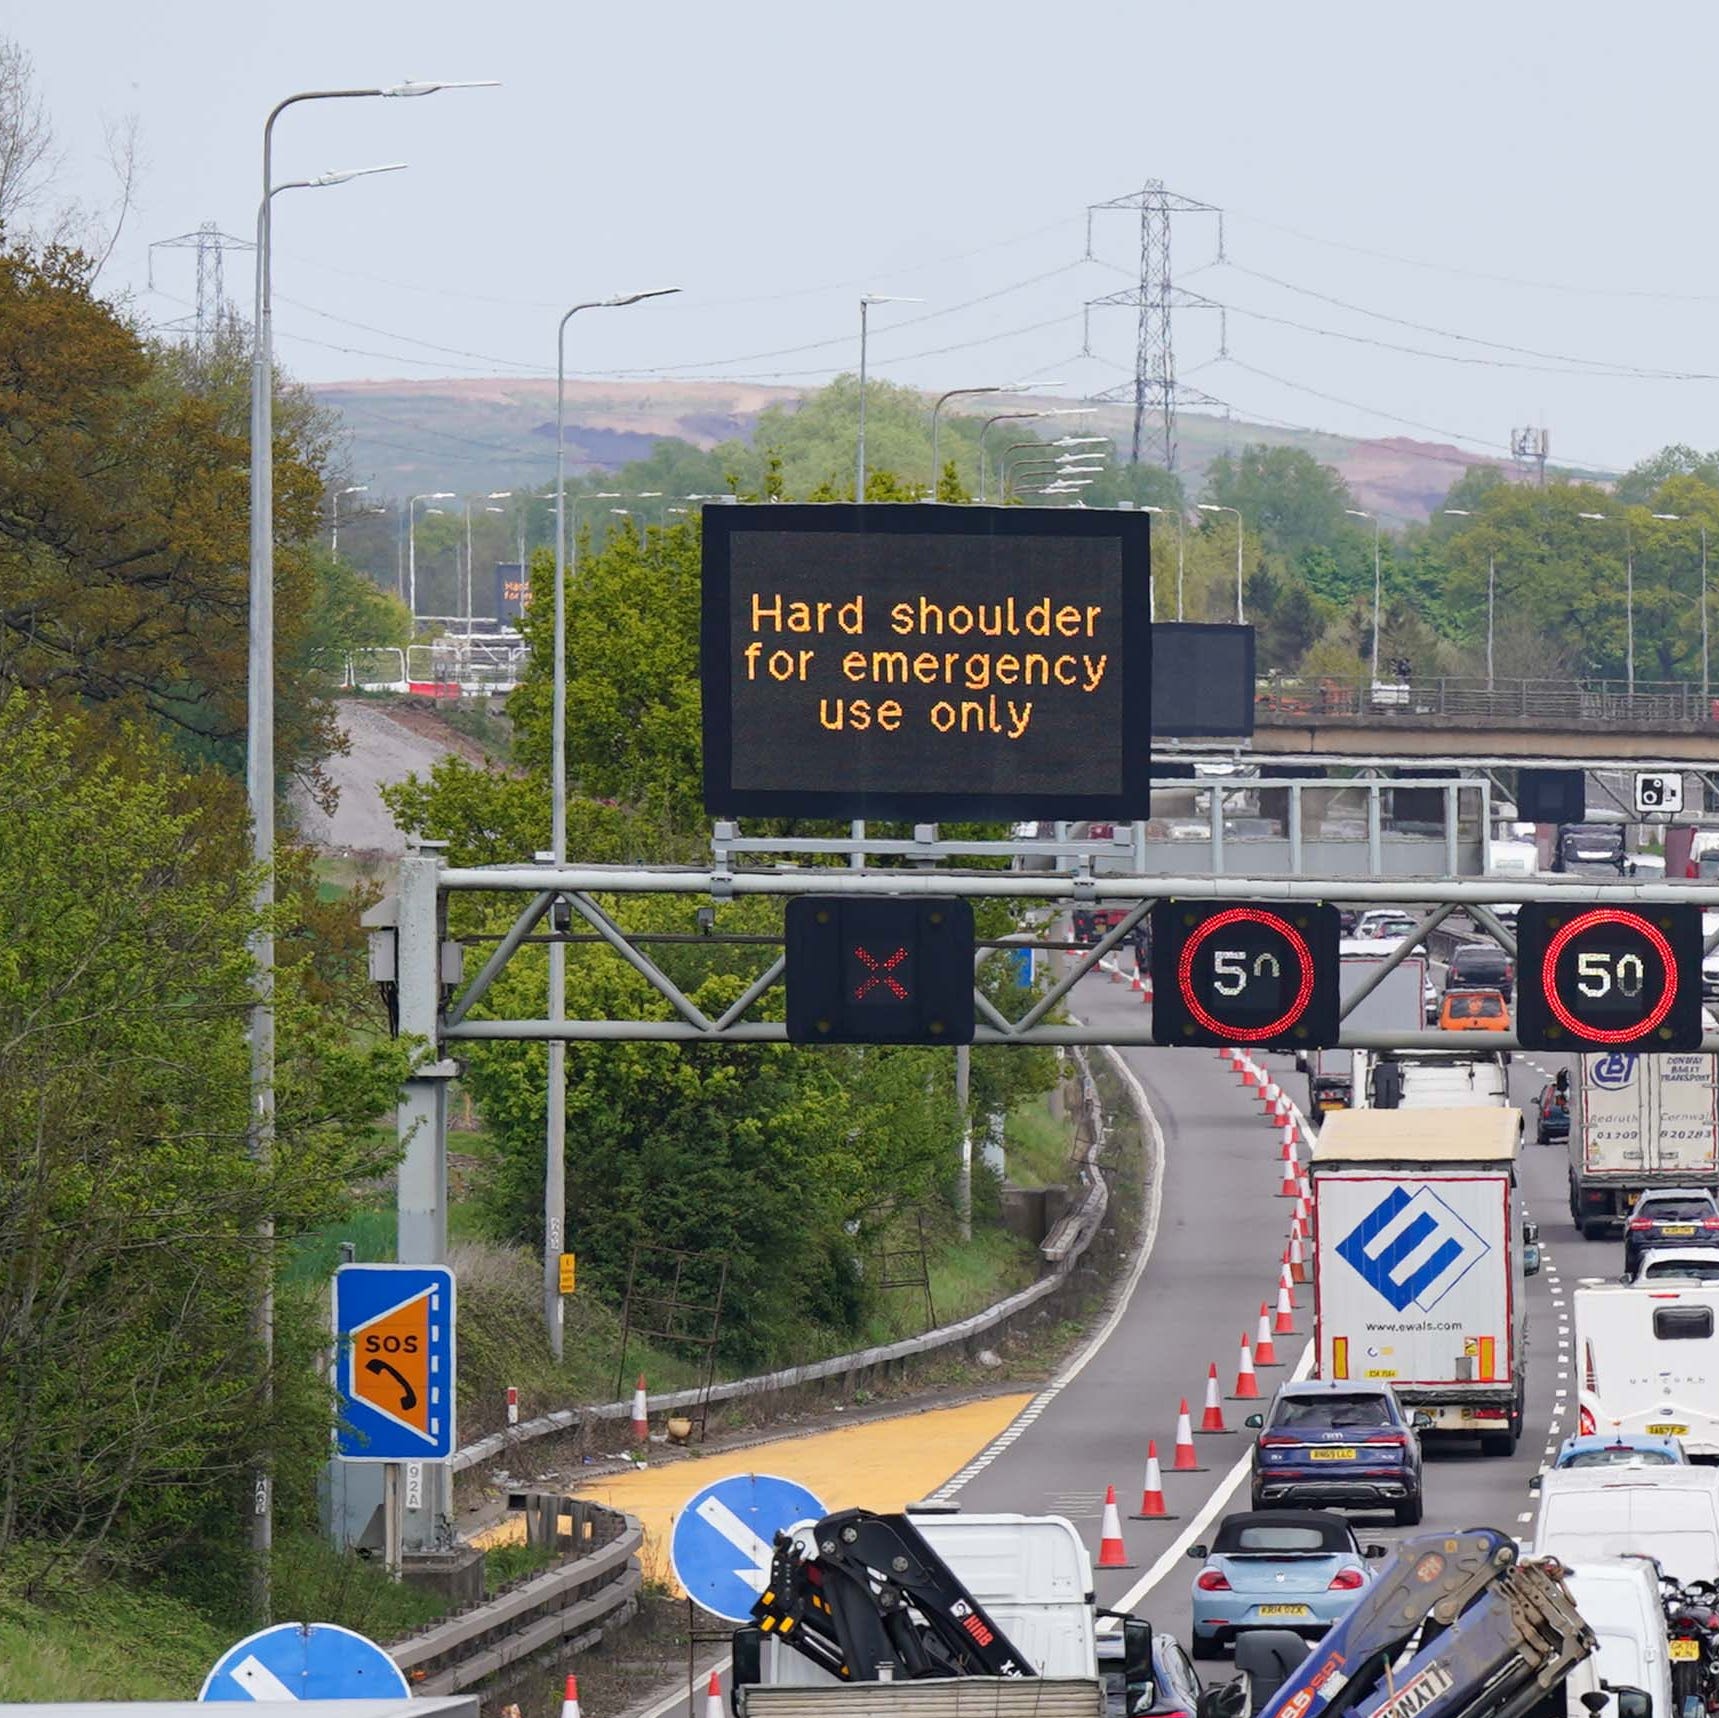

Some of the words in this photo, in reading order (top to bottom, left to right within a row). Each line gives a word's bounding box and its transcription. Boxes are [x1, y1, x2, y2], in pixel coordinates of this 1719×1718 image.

[750, 593, 865, 634] Hard
[890, 596, 1102, 637] shoulder
[743, 642, 815, 681] for
[842, 650, 1107, 692] emergency
[819, 698, 903, 730] use
[930, 694, 1034, 739] only
[1577, 953, 1645, 998] 50
[365, 1334, 418, 1354] SOS
[1366, 1321, 1463, 1333] www.ewals.com
[962, 1614, 995, 1648] HIAB
